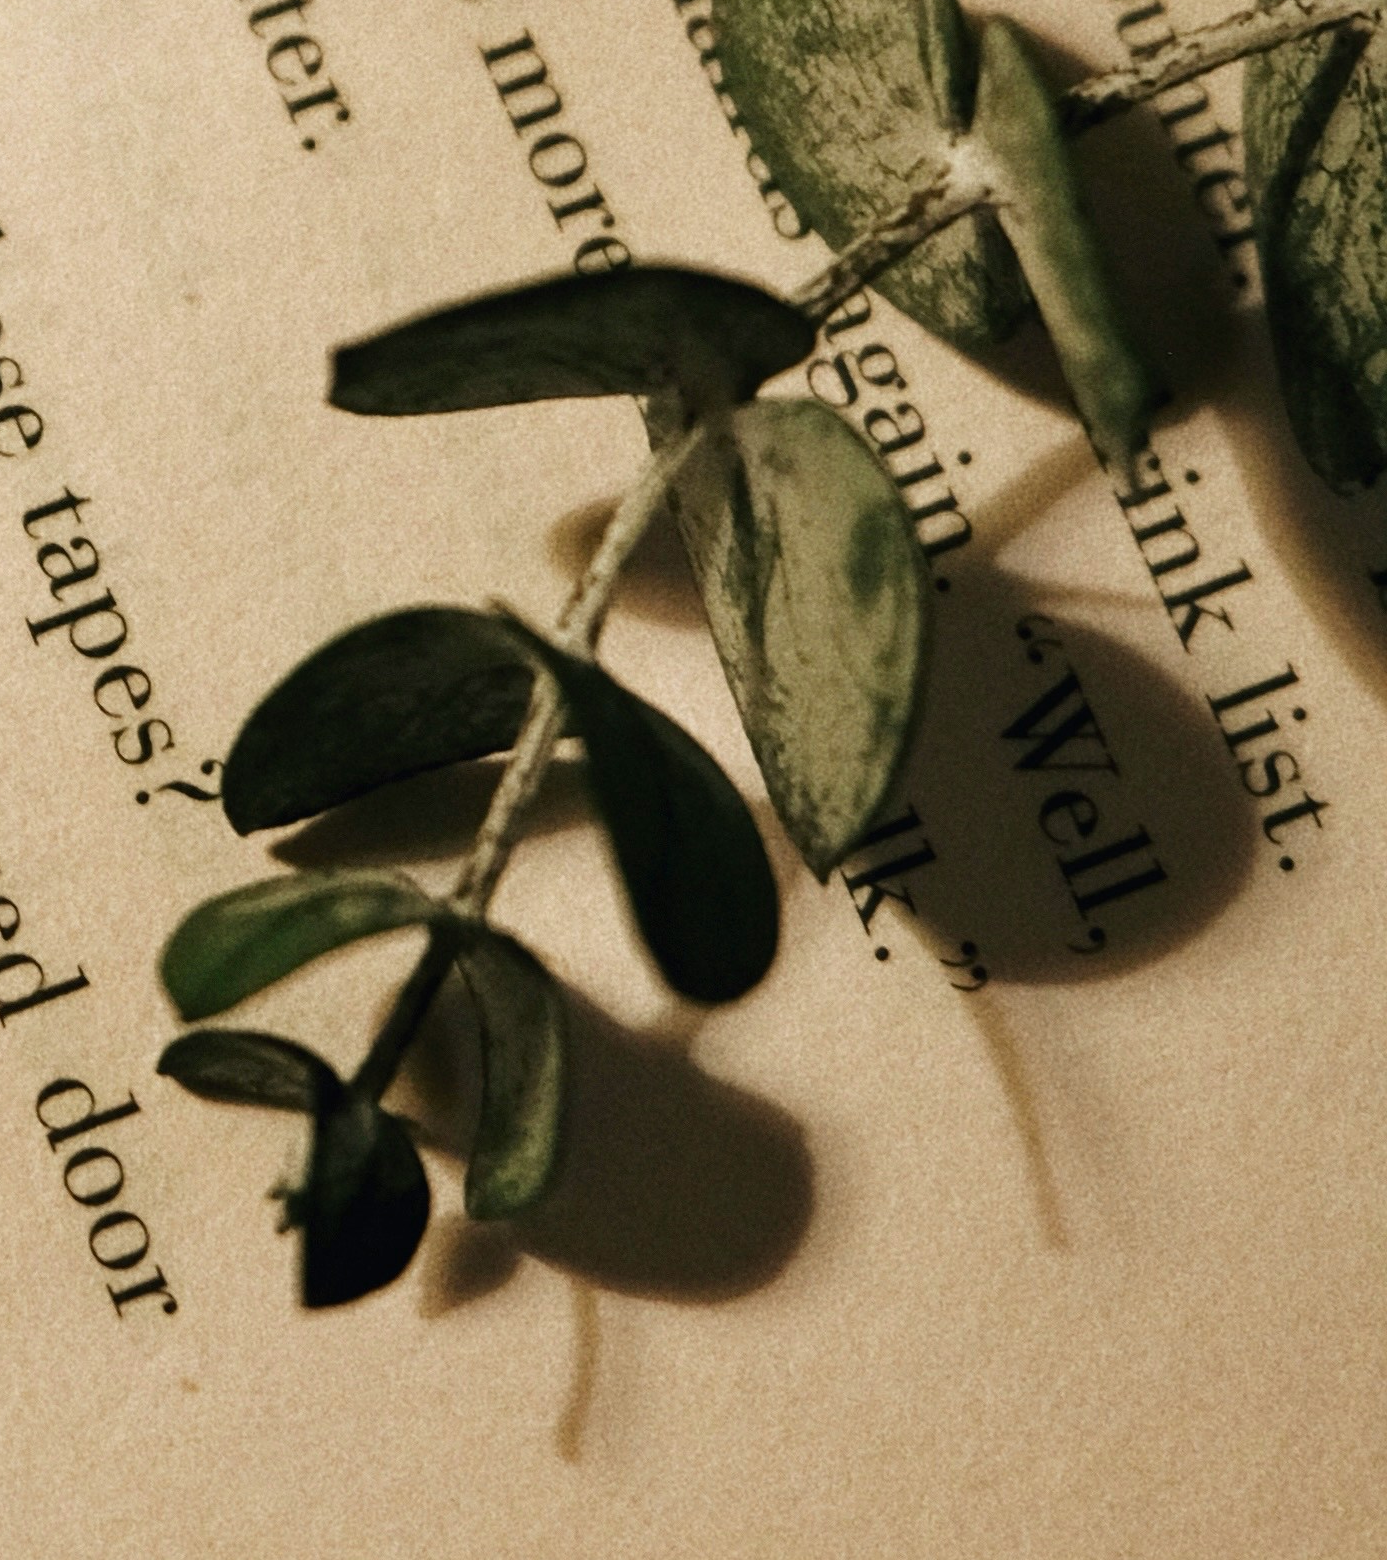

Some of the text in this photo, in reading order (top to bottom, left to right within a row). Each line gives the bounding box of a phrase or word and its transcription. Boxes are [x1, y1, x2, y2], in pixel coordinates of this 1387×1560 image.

[471, 27, 645, 284] more
[12, 487, 238, 823] tapes?
[797, 284, 991, 599] again.
[999, 619, 1170, 954] “Well,
[1202, 663, 1338, 877] list.
[34, 1076, 179, 1318] door
